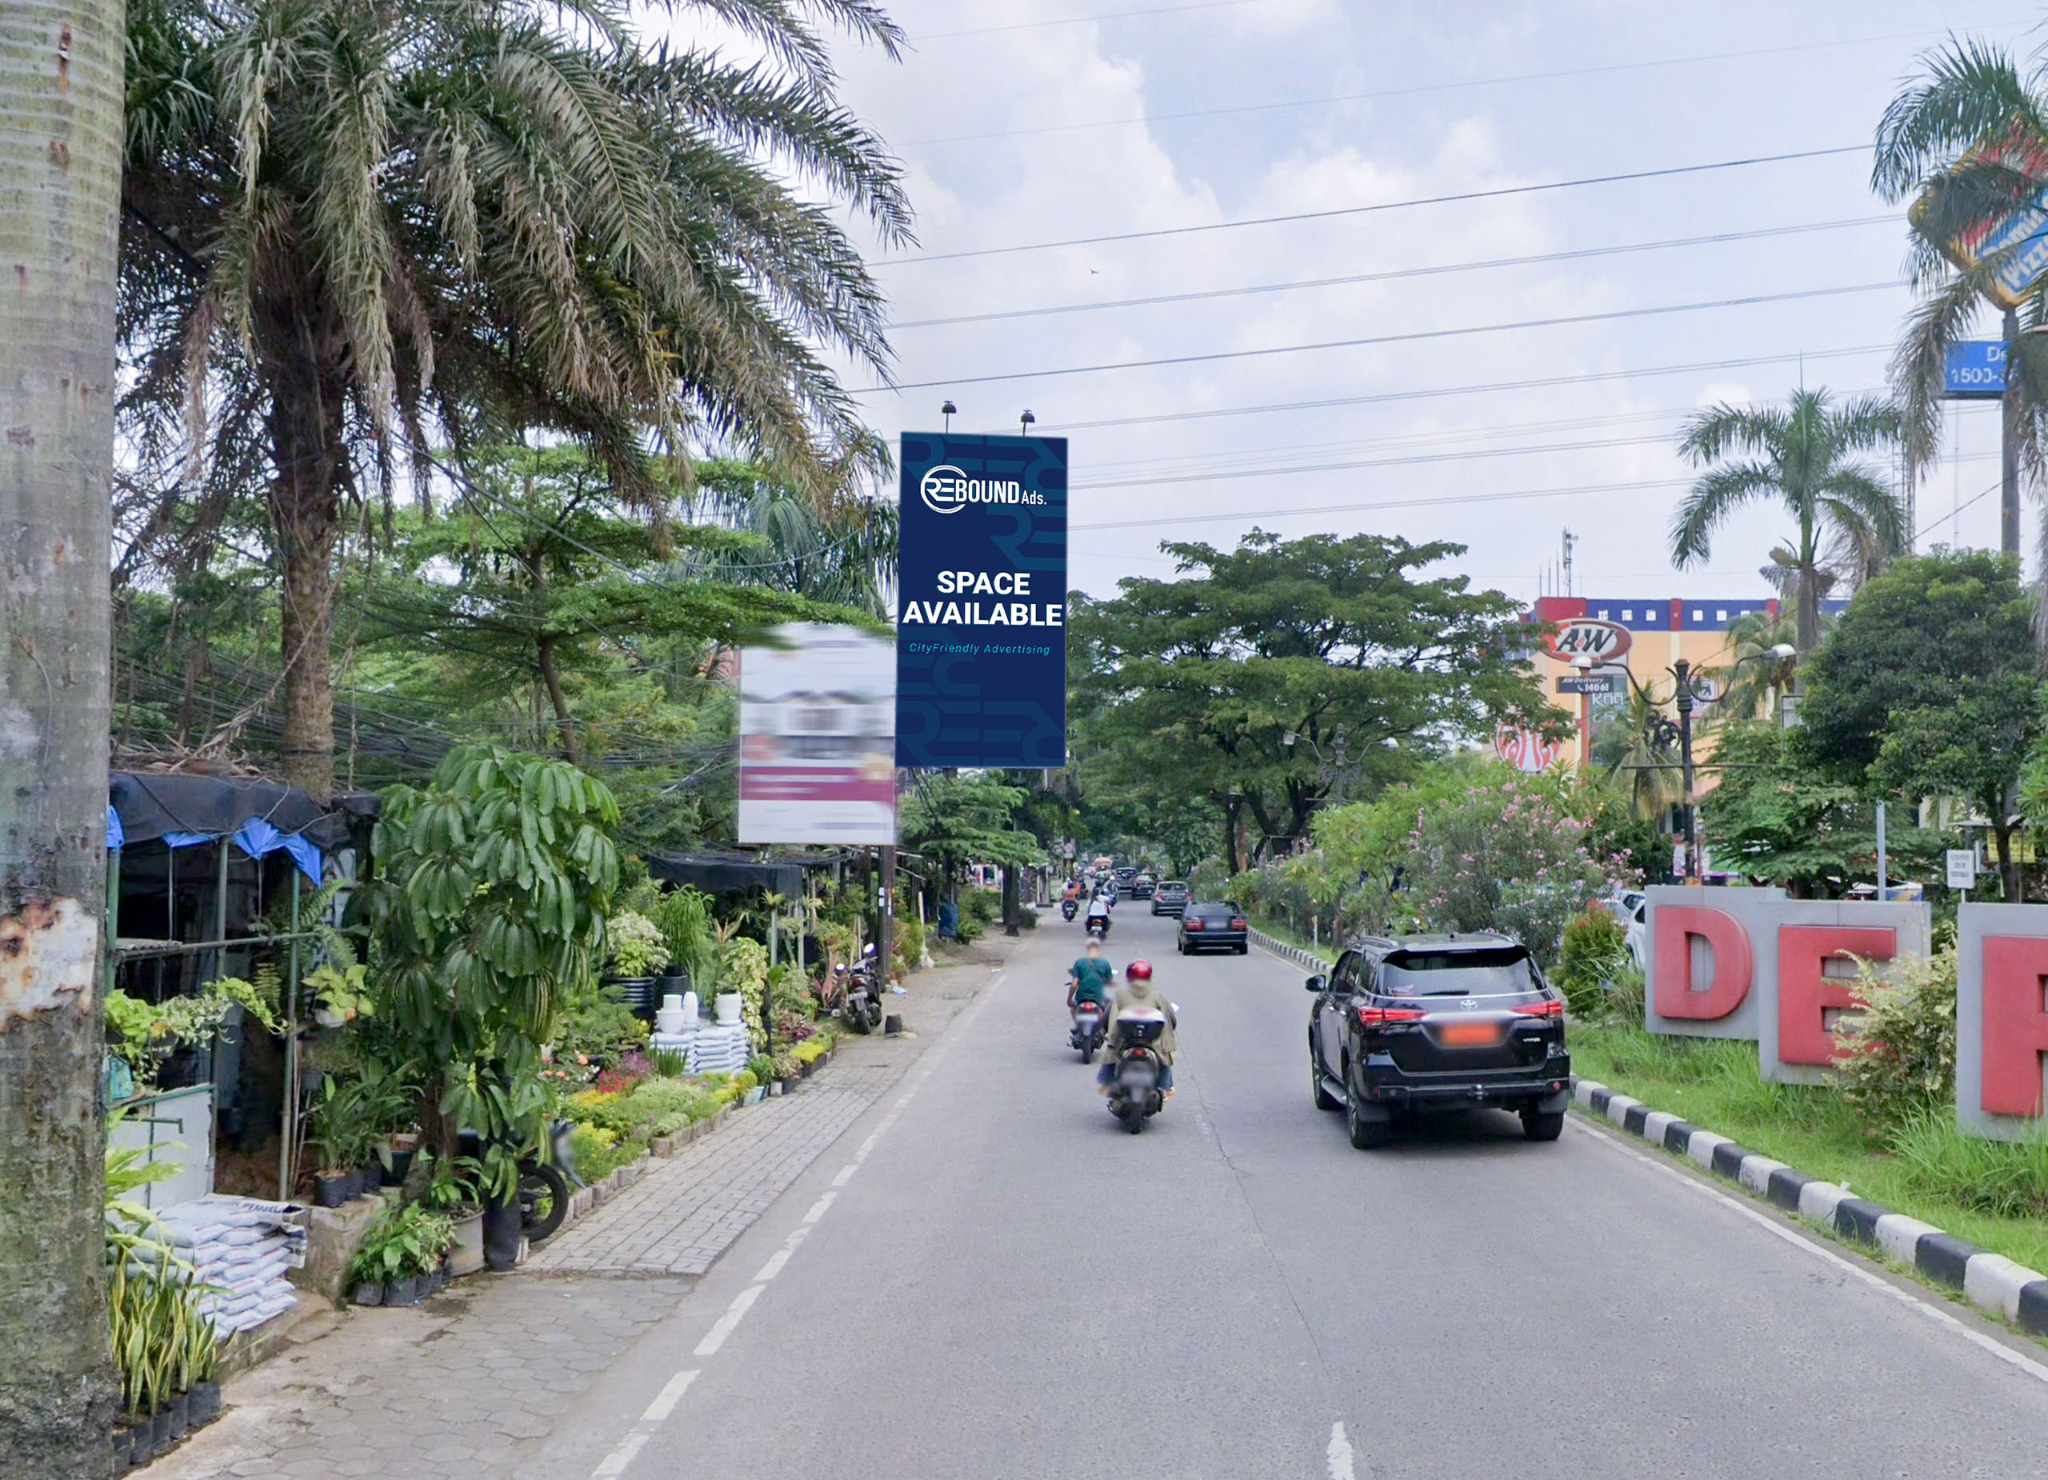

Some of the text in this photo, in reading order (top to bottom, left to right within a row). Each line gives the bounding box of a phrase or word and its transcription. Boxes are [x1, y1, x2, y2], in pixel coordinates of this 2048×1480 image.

[1021, 488, 1047, 505] Ads.
[937, 571, 1031, 595] SPACE
[902, 601, 1063, 626] AVAILABLE
[909, 642, 1050, 656] CityFriendly Advertising
[1584, 683, 1610, 692] 14061
